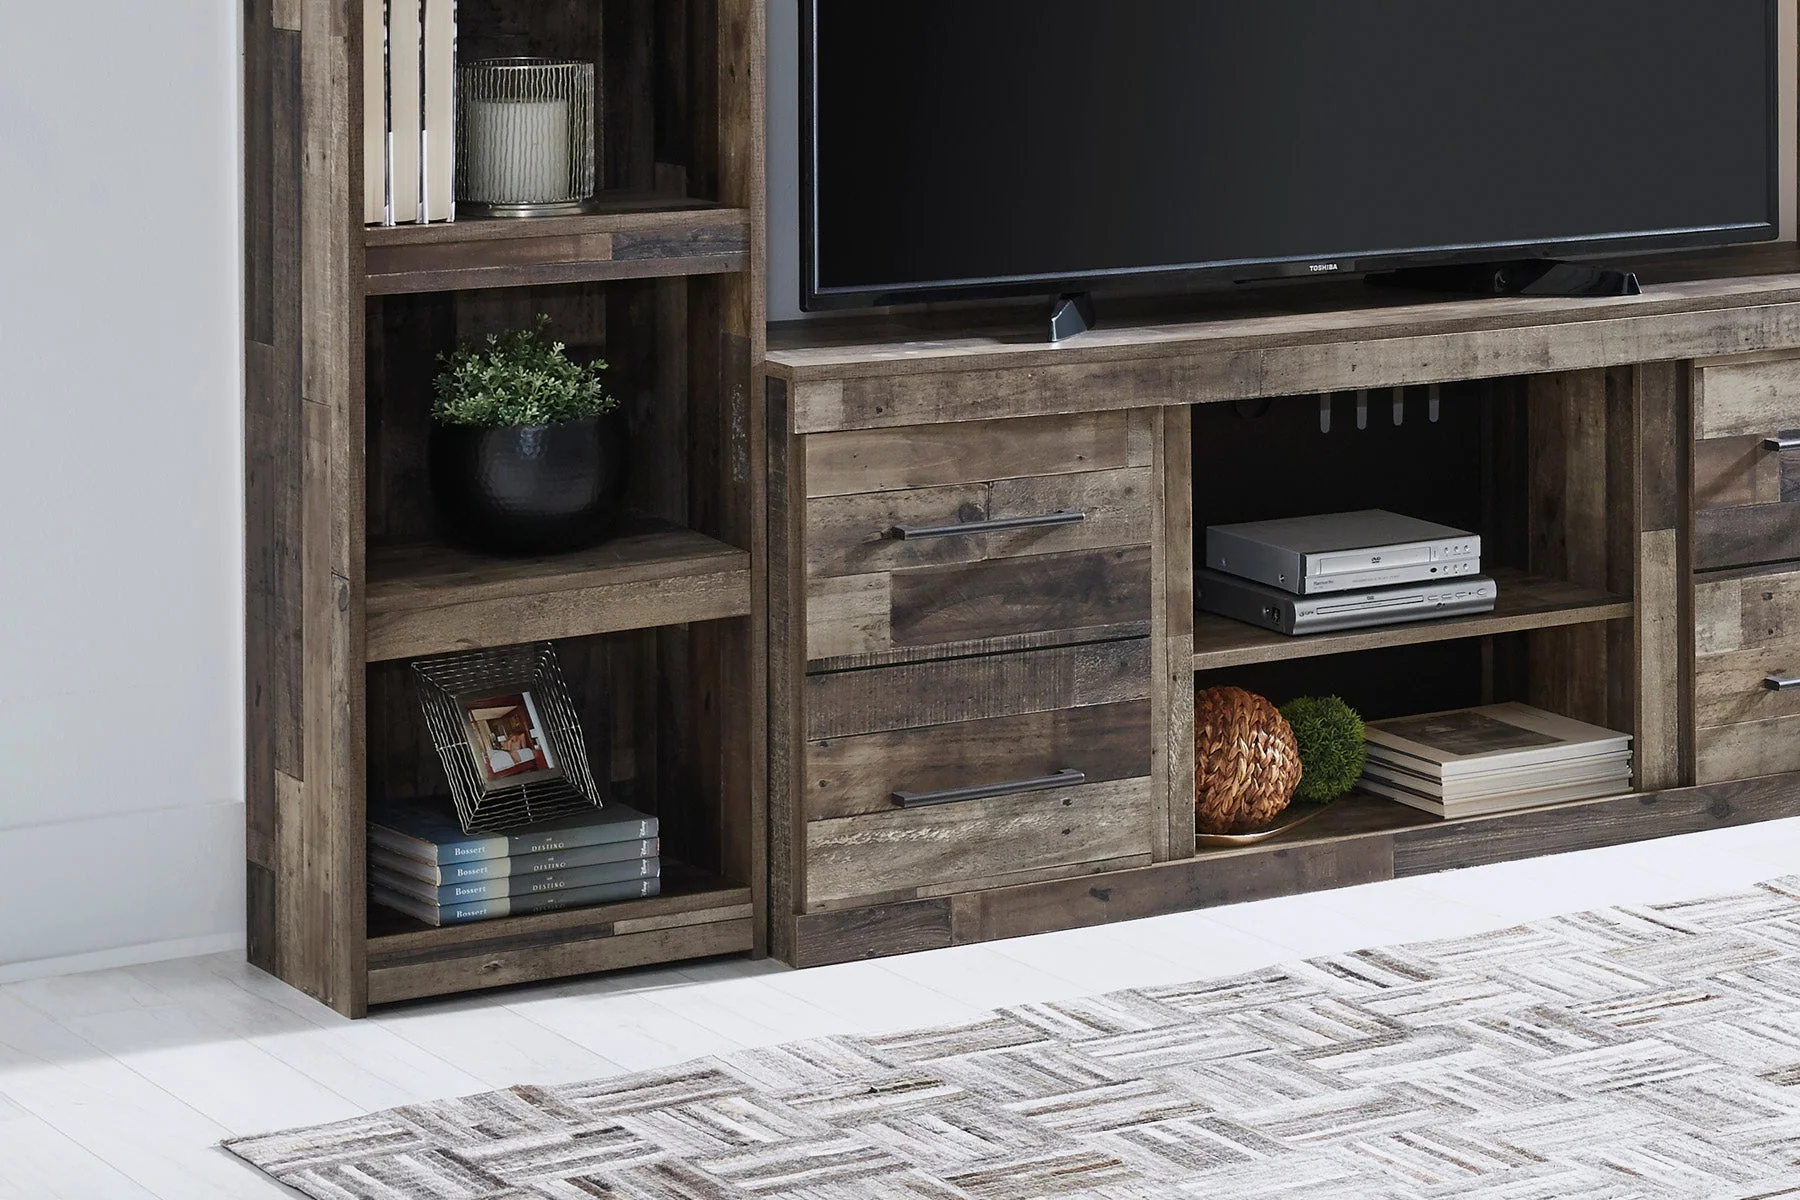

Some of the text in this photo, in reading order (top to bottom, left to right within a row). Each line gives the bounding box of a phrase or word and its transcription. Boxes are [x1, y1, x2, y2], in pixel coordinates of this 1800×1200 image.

[1309, 263, 1338, 271] TOSHIBA
[454, 846, 486, 856] Bossert
[531, 842, 565, 852] DESTINO
[457, 866, 488, 877] Bossert
[533, 862, 567, 872] DESTINO
[455, 886, 487, 896] Bossert
[532, 882, 566, 891] DESTINO
[456, 908, 488, 918] Bossert
